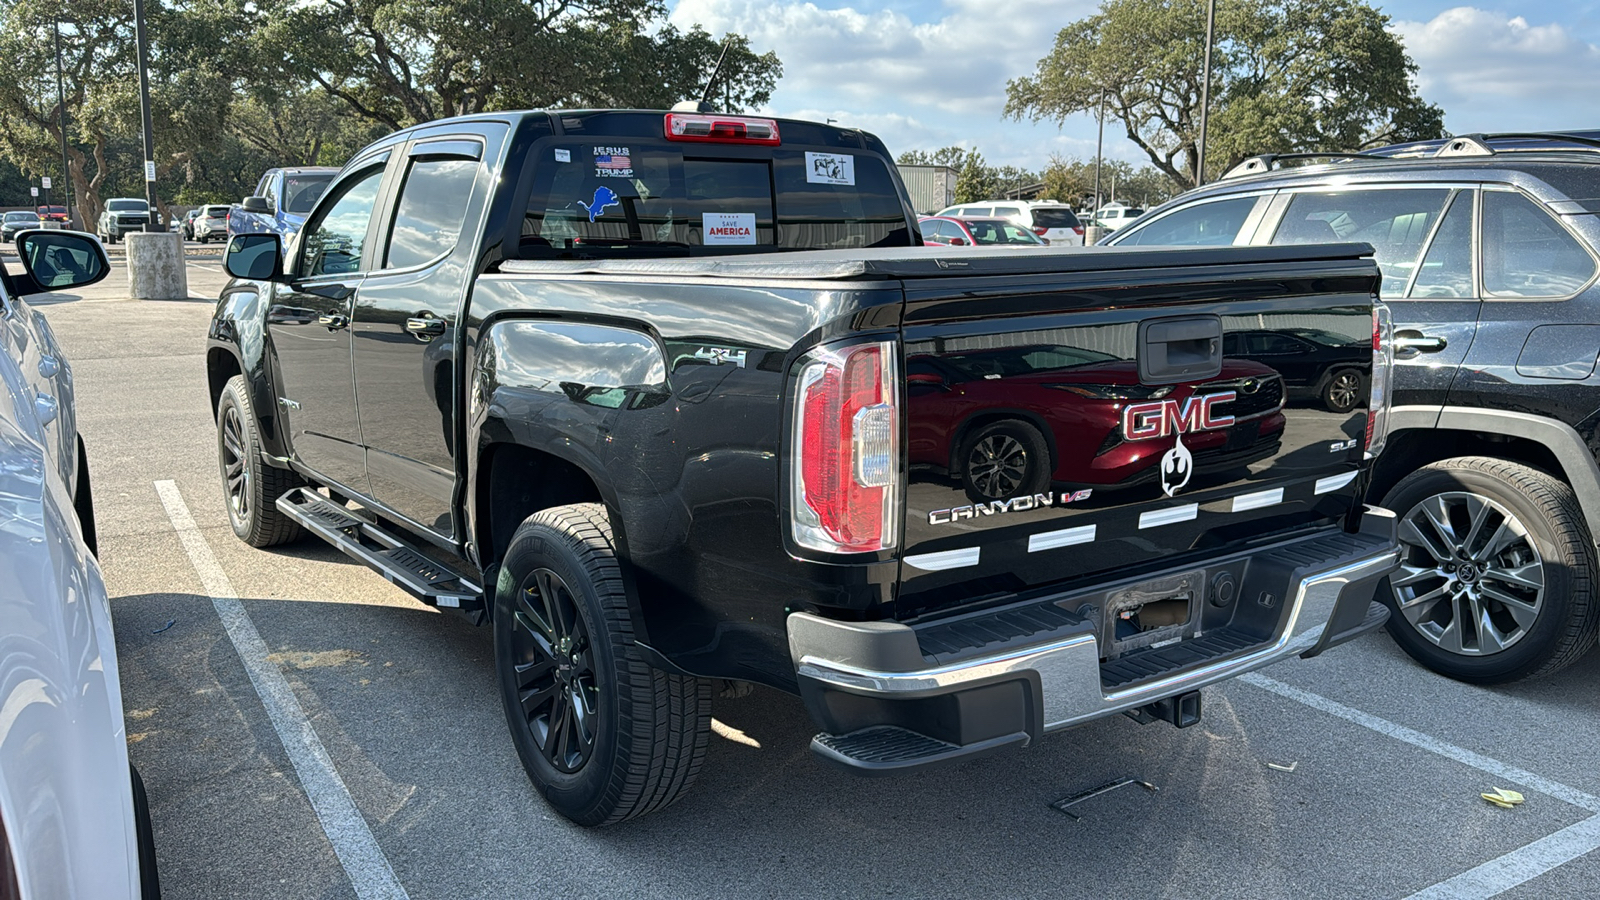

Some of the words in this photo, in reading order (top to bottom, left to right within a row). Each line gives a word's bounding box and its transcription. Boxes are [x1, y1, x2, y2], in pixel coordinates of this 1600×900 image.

[709, 227, 750, 235] AMERICA
[1122, 391, 1237, 442] GMC
[1329, 438, 1358, 453] SLE
[928, 491, 1053, 525] CANYON
[1060, 488, 1094, 504] V6
